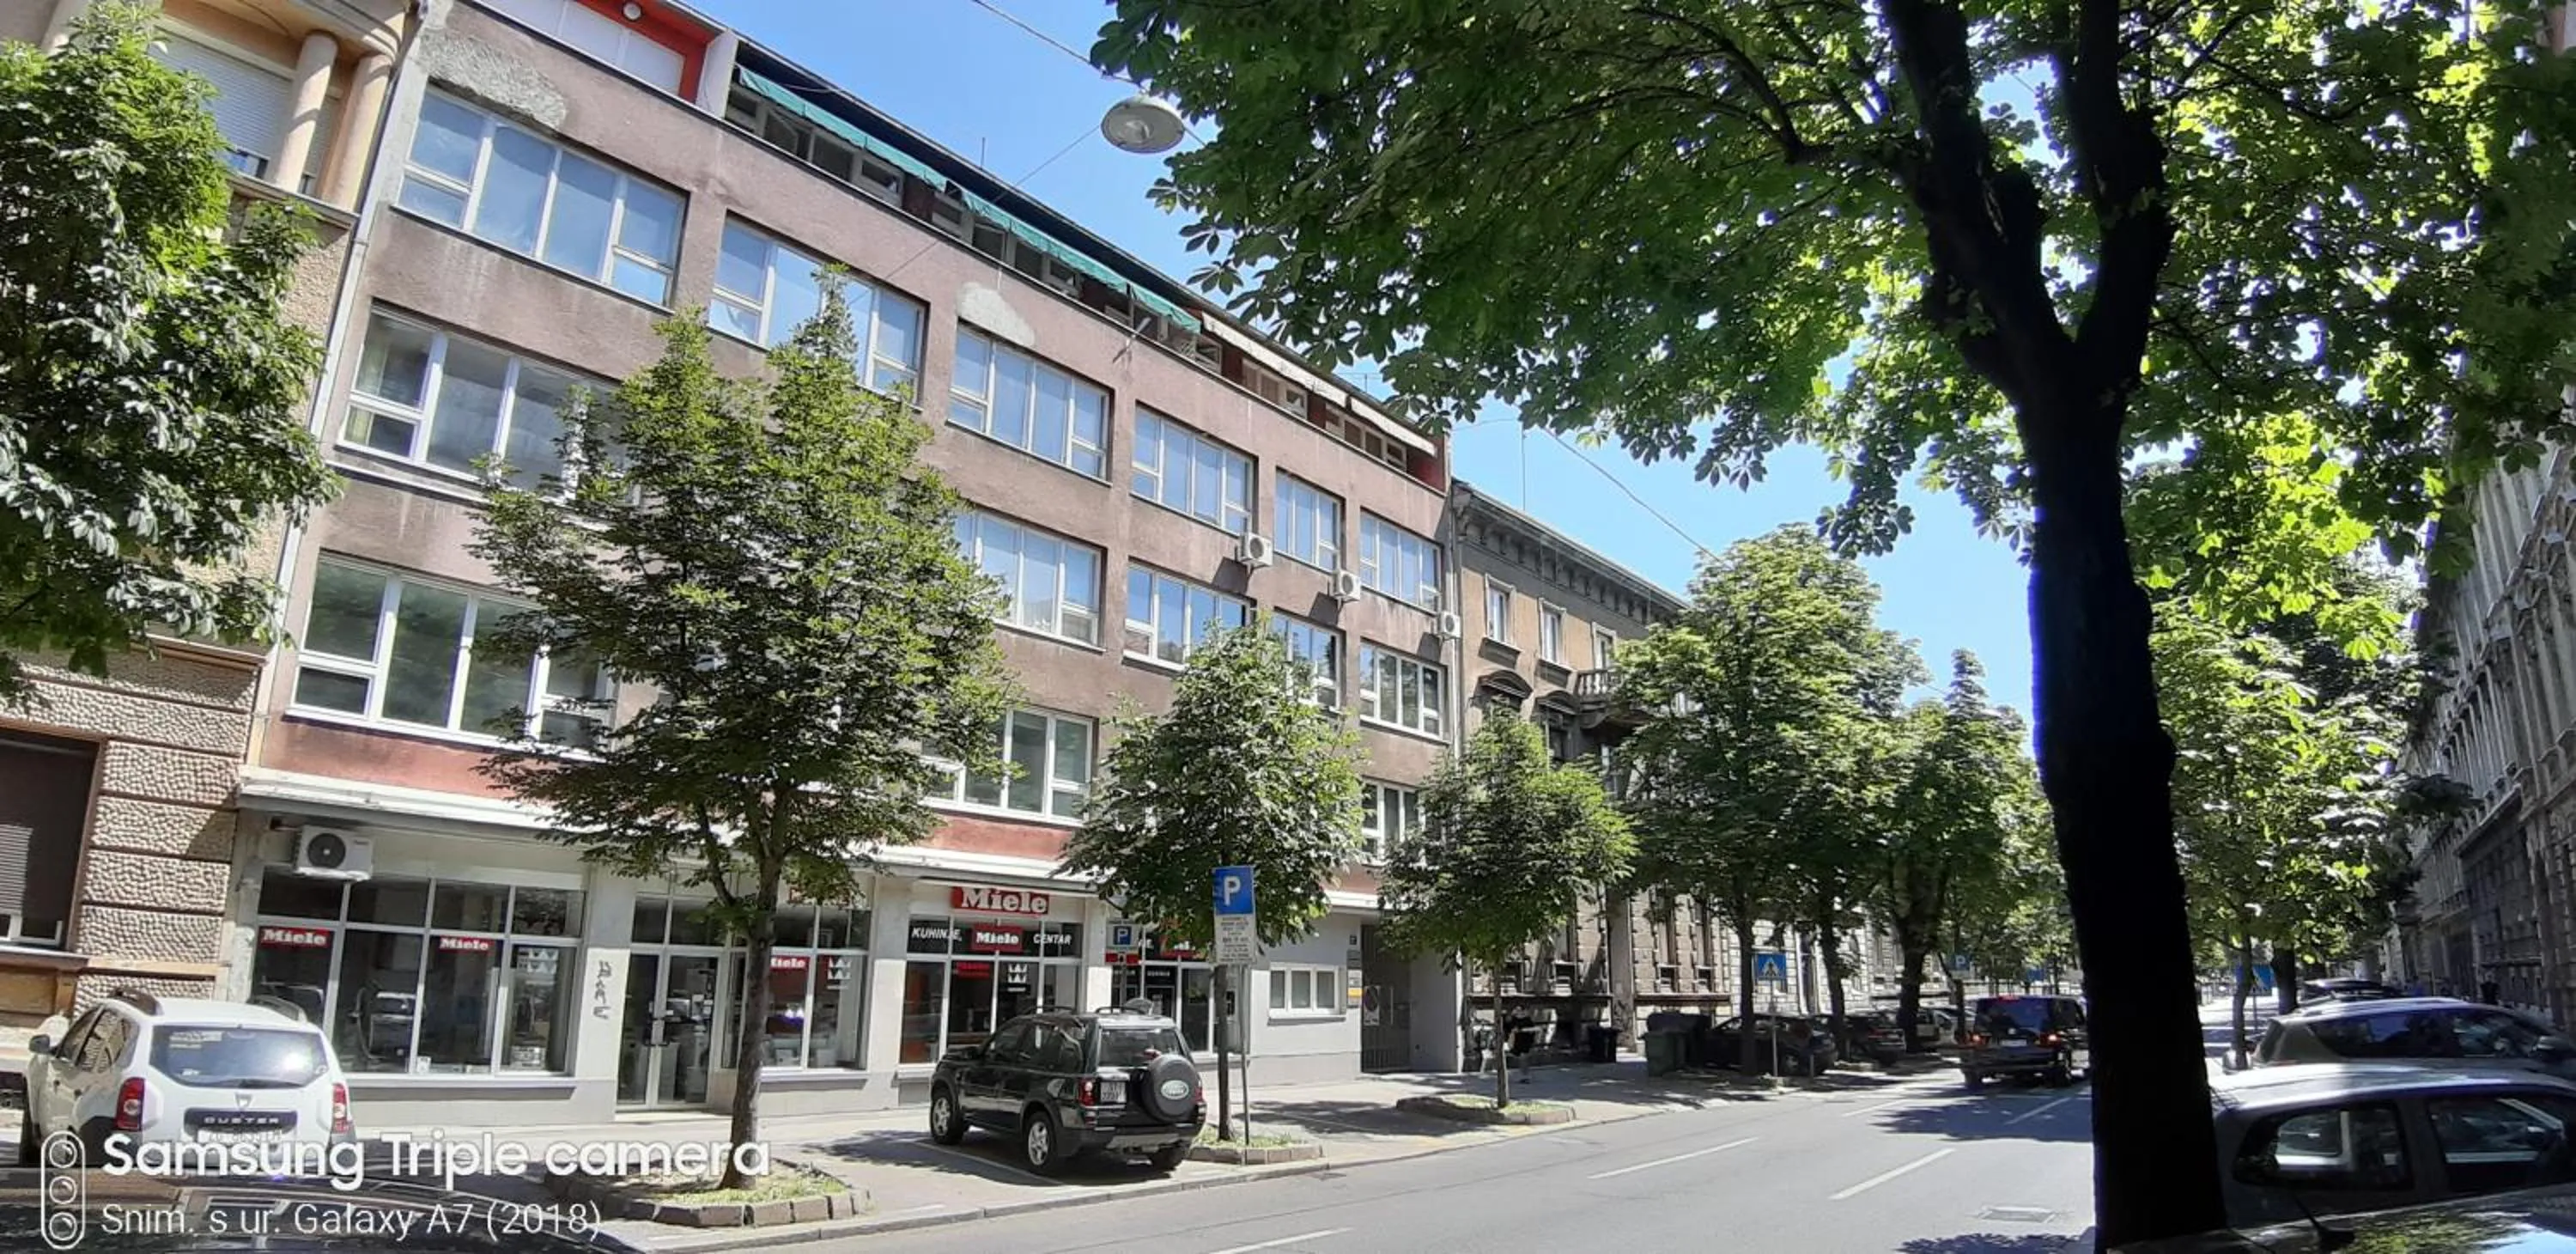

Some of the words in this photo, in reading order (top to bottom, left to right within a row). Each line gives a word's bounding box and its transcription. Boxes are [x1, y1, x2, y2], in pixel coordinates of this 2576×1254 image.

[1224, 875, 1241, 907] P
[962, 888, 1047, 912] Miele
[261, 929, 327, 946] Miele
[977, 933, 1019, 945] Miele
[1033, 934, 1071, 945] CENTAR
[1117, 928, 1128, 944] P
[440, 938, 489, 951] Miele
[1956, 955, 1966, 968] P
